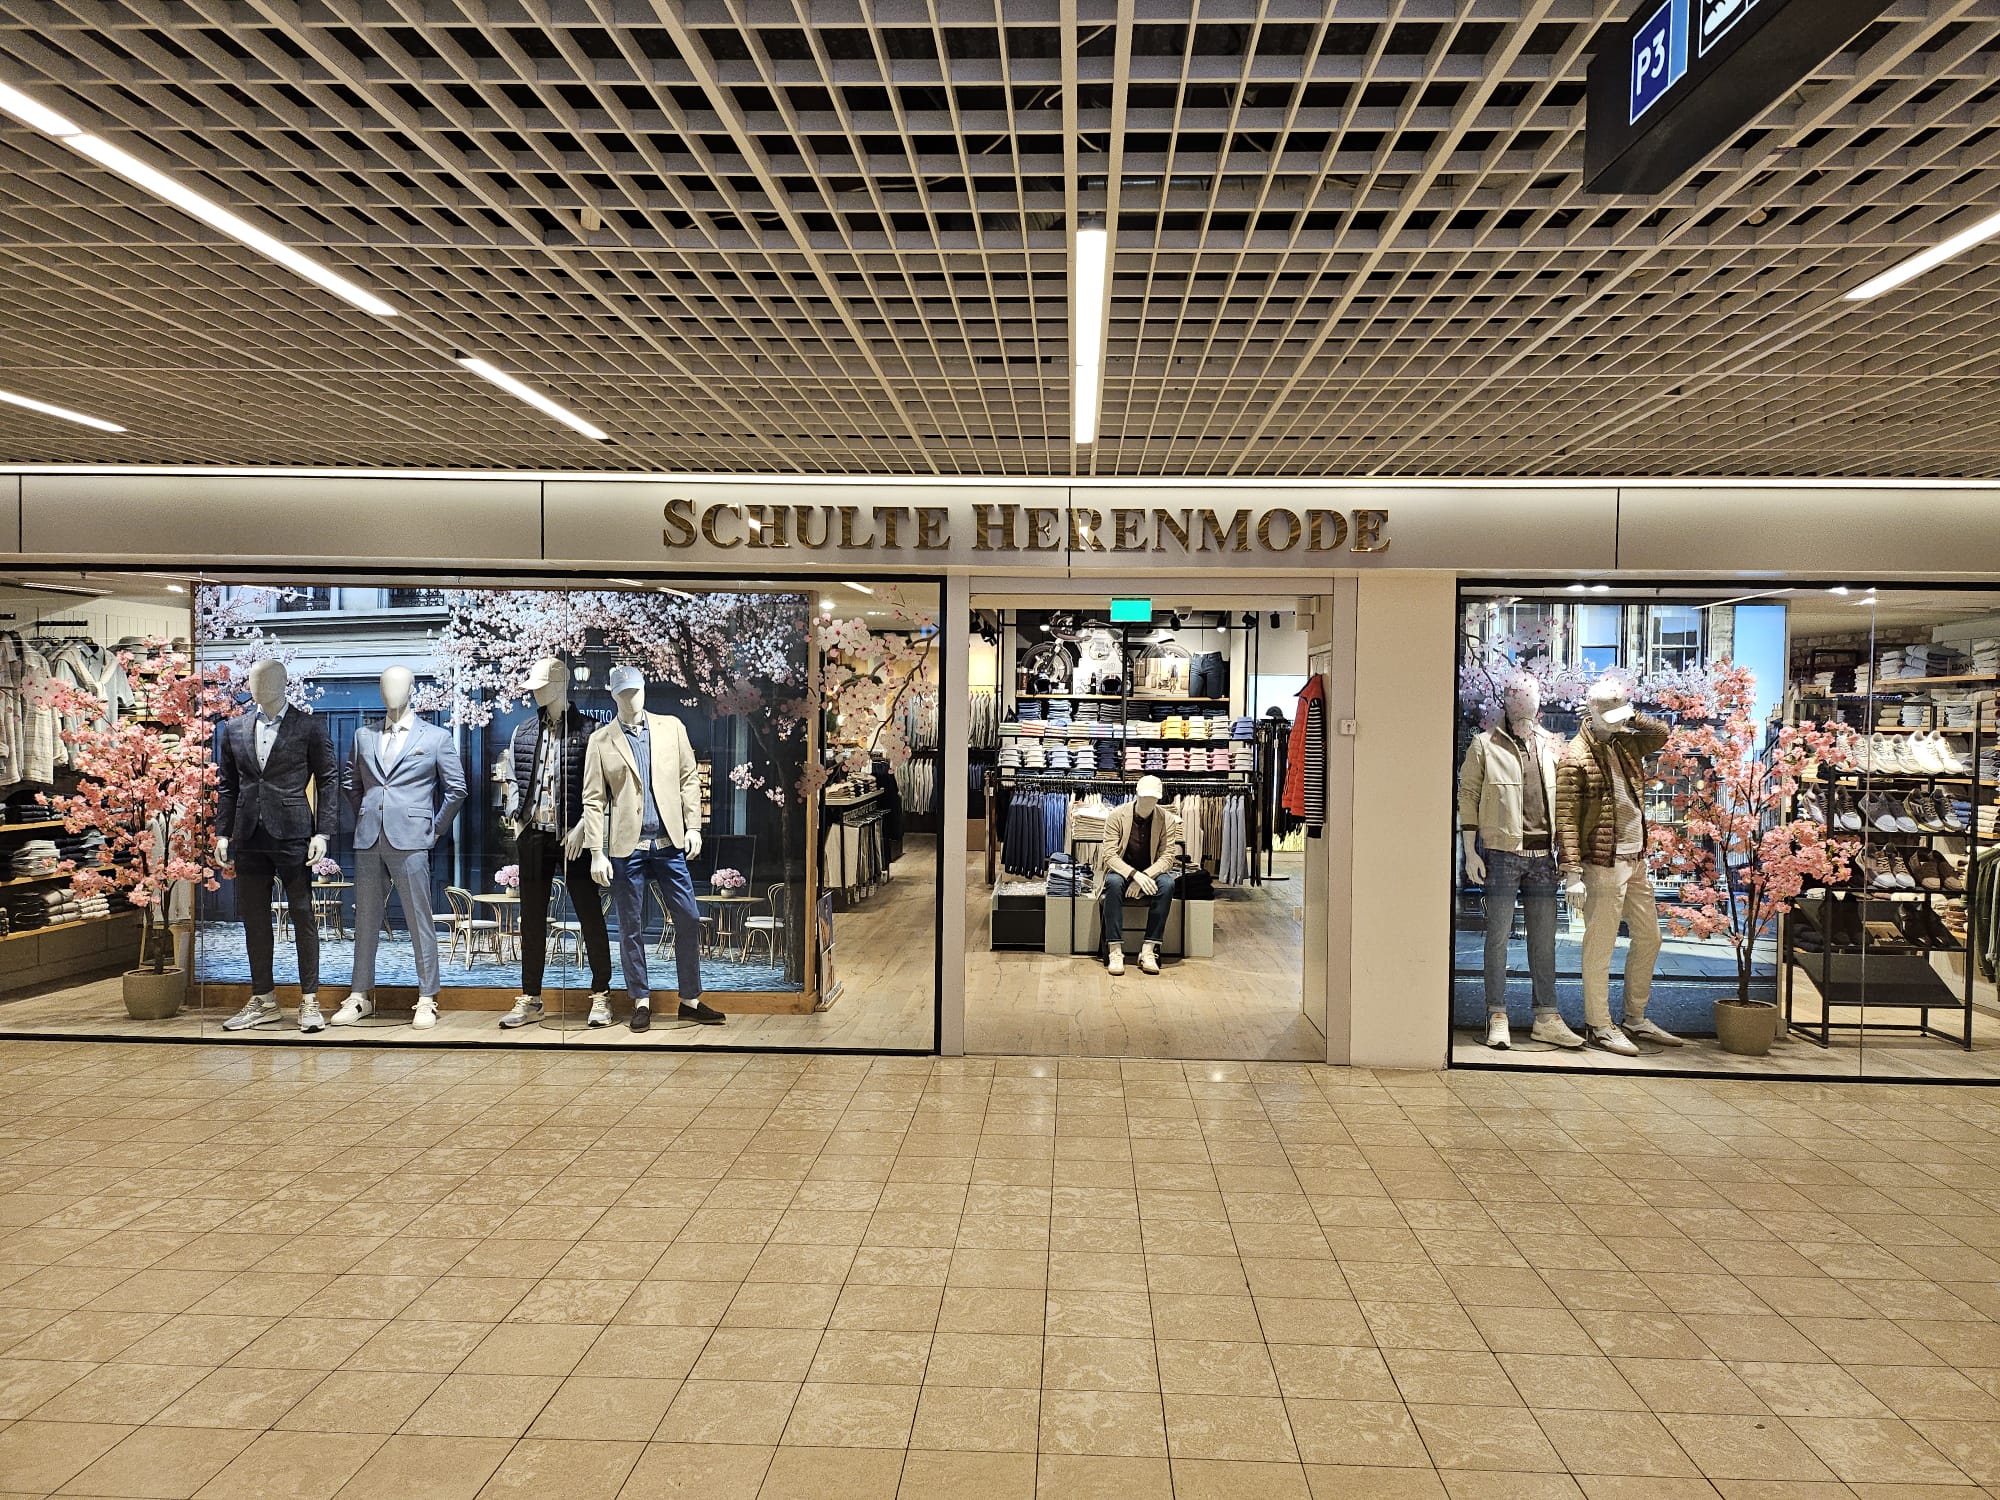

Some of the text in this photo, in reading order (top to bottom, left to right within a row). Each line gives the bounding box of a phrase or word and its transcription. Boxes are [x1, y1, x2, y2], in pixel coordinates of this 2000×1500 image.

[1636, 28, 1666, 96] P3
[663, 498, 1392, 553] SCHULTE HERENMODE
